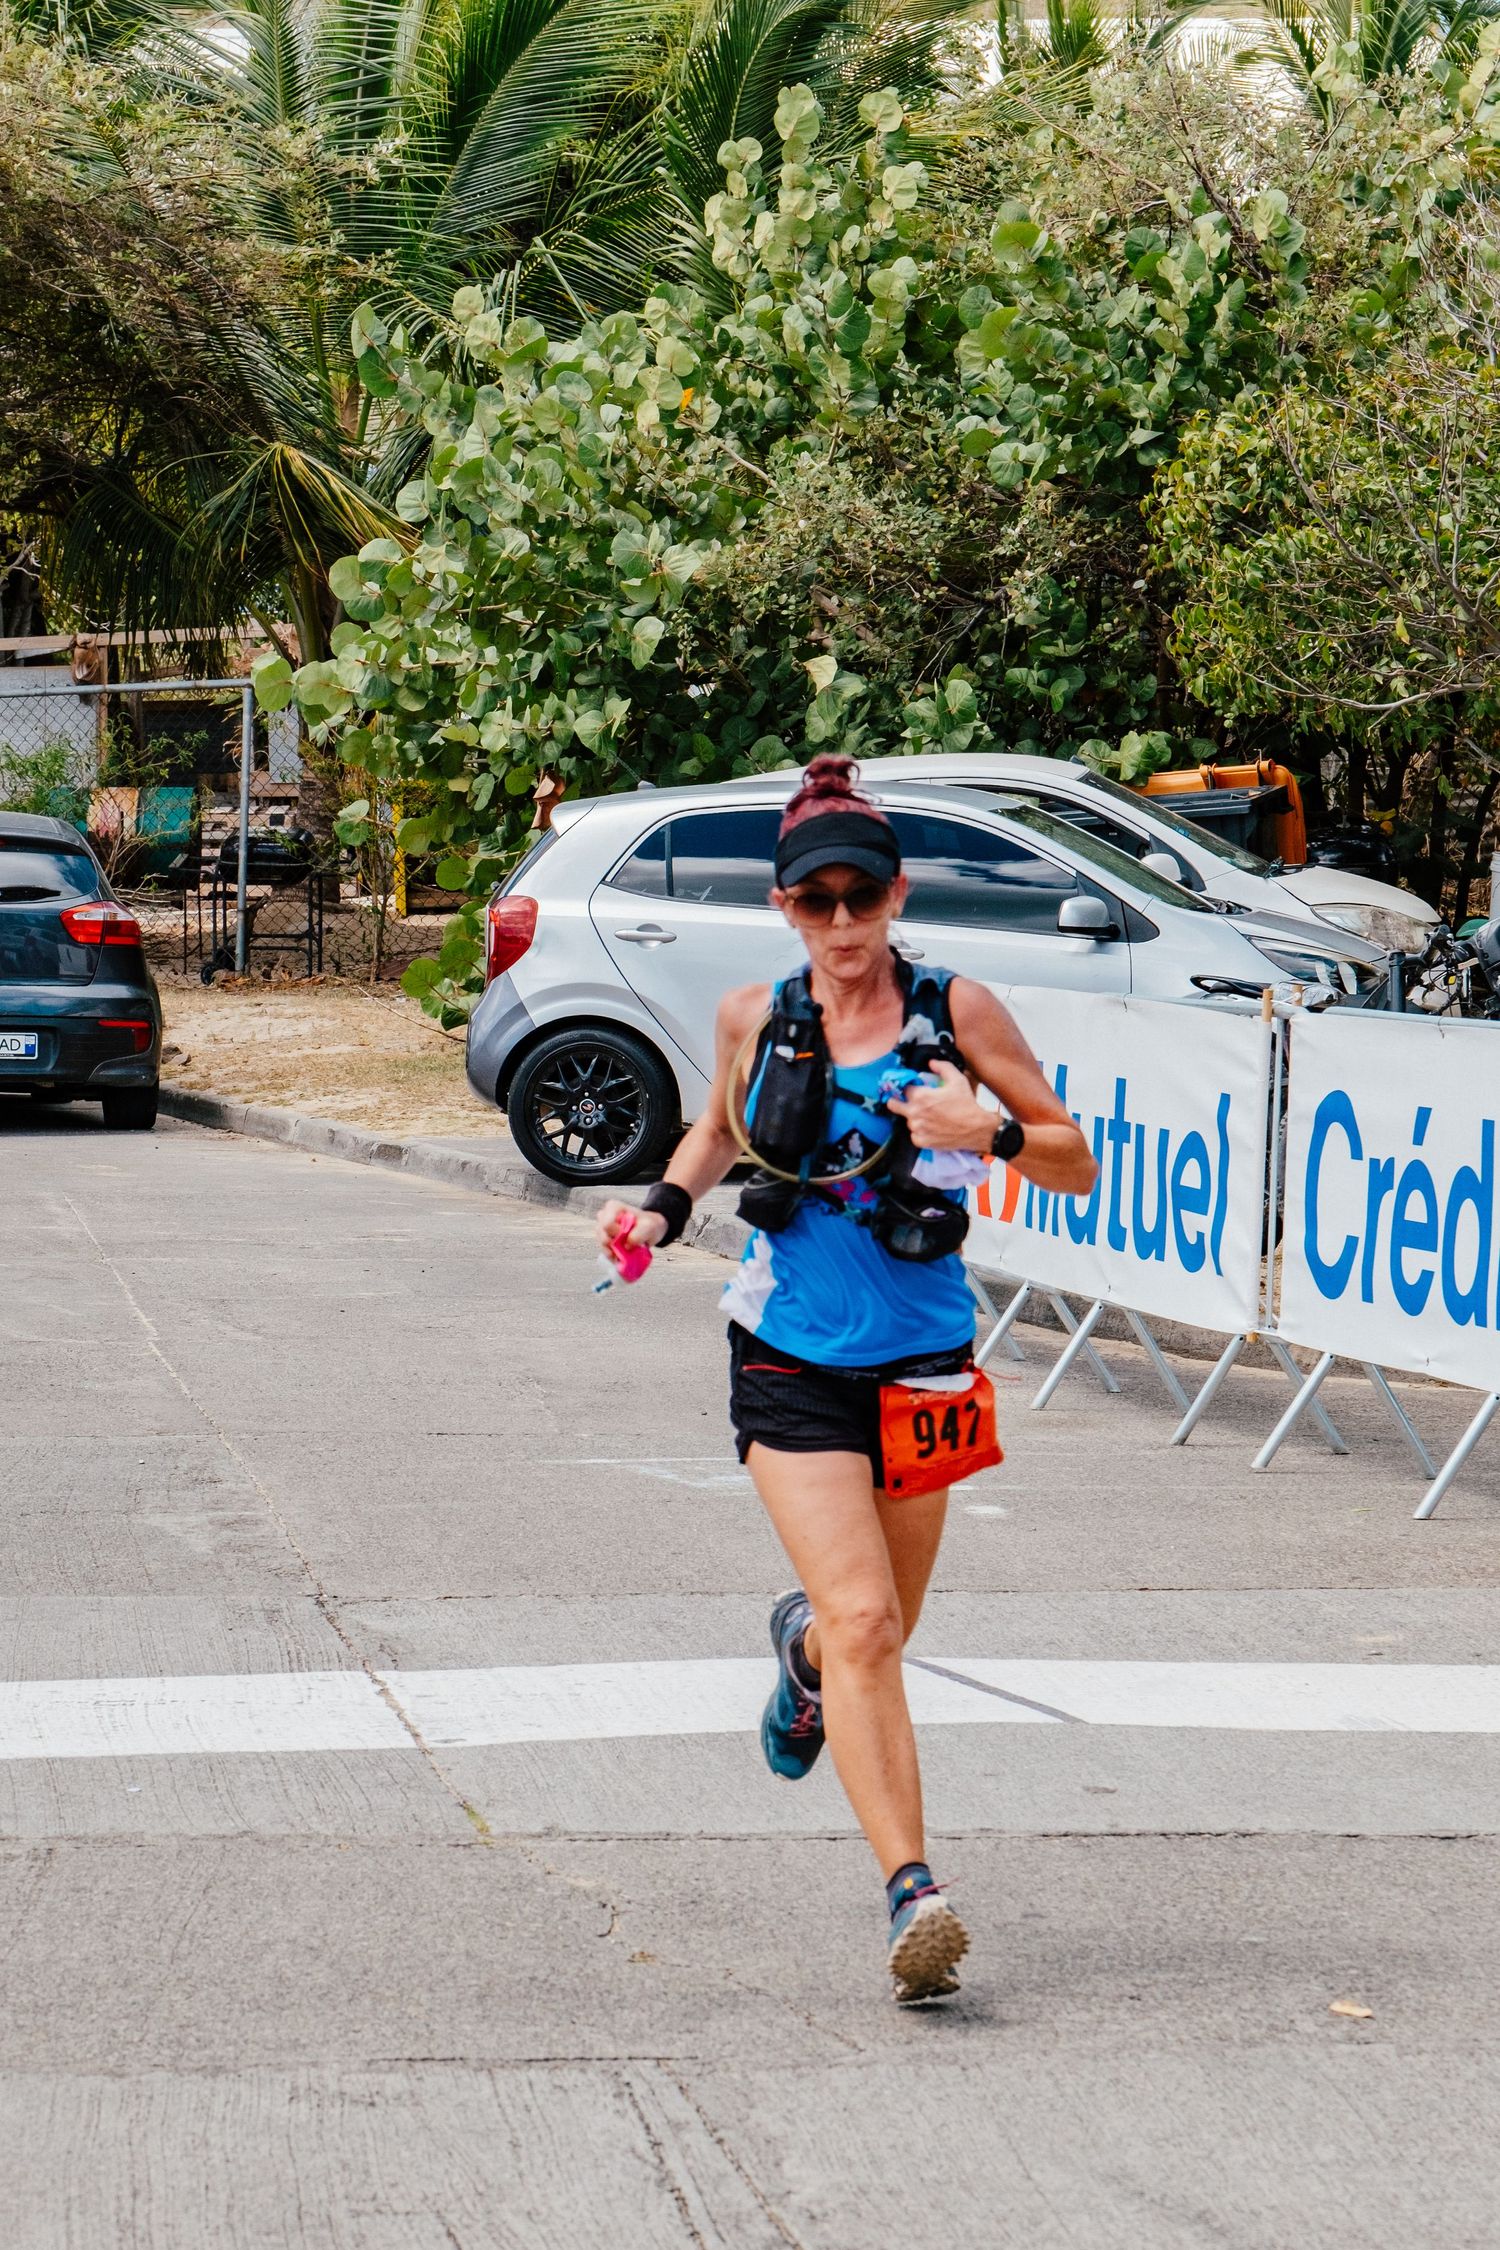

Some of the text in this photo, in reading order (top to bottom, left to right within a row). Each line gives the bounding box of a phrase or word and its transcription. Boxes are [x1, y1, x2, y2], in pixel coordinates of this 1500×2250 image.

[0, 1038, 21, 1051] AD
[1304, 1090, 1500, 1330] Créd
[912, 1398, 981, 1459] 947
